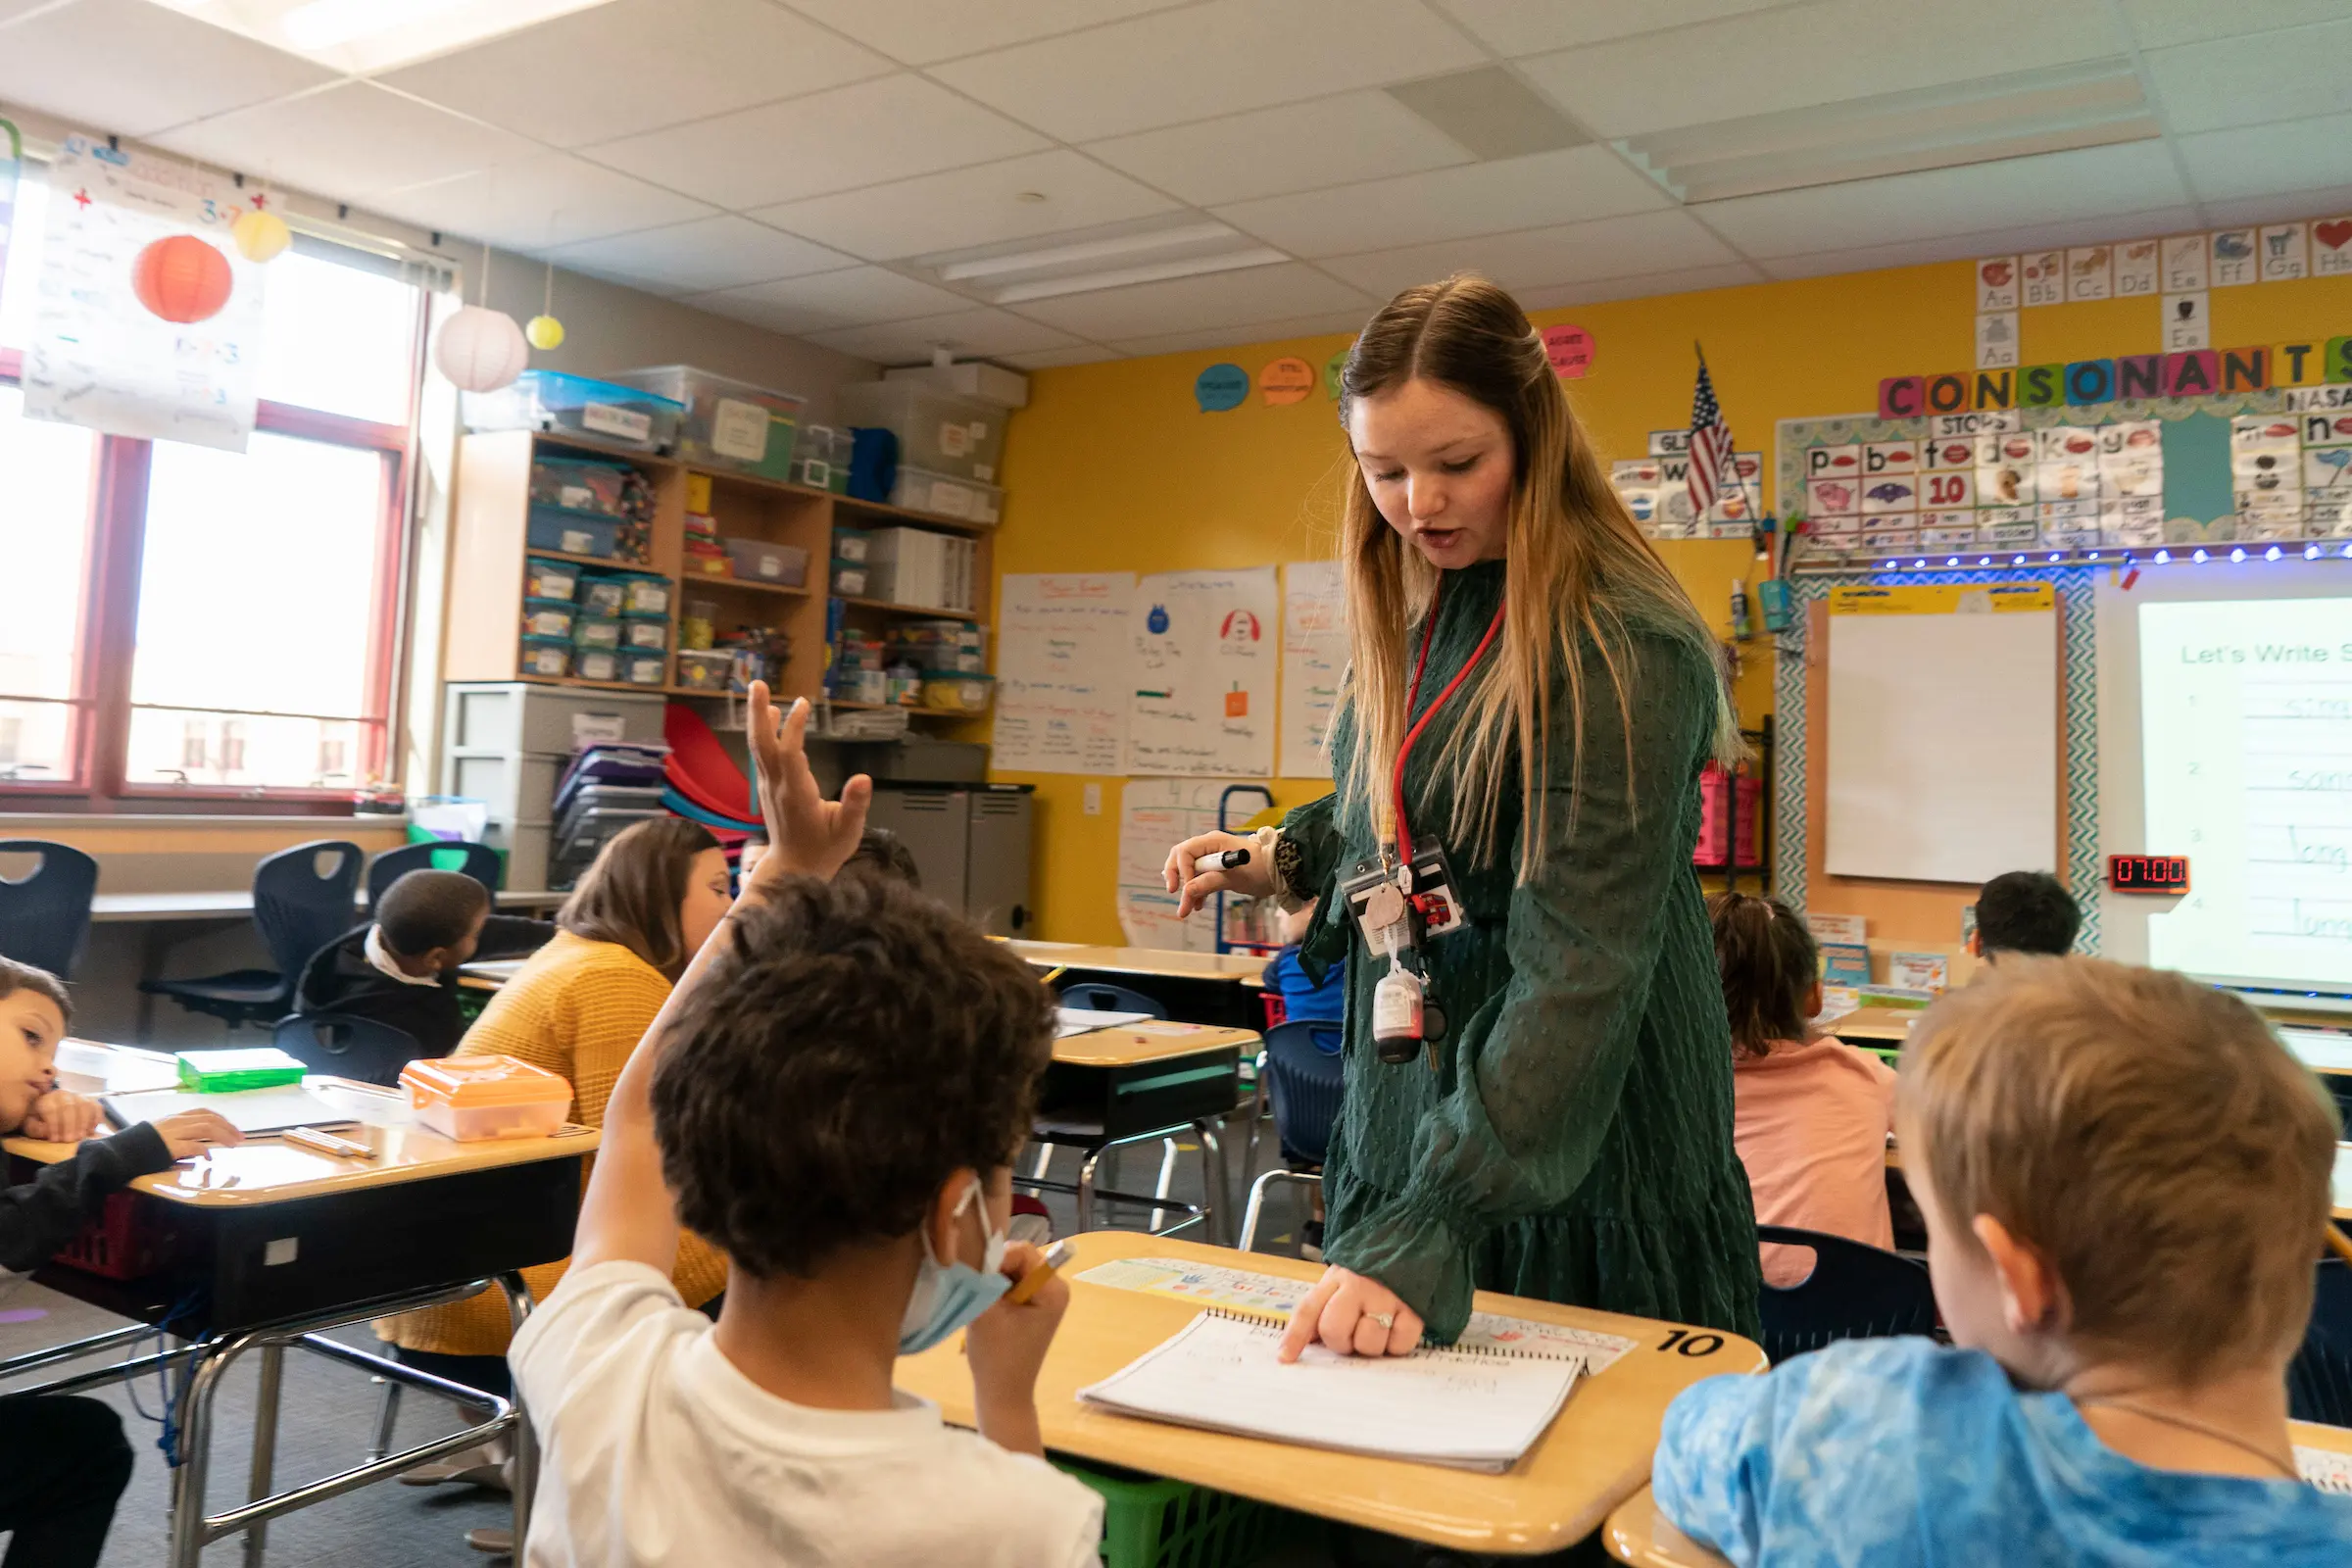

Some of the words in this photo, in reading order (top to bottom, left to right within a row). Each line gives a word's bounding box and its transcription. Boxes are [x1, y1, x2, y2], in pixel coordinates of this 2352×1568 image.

[2220, 263, 2243, 284] Ff
[2266, 258, 2302, 278] Gg
[2076, 279, 2104, 298] Cc
[2122, 273, 2153, 294] Dd
[2172, 270, 2197, 289] Ee
[1984, 291, 2013, 309] Aa
[2029, 284, 2057, 303] Bb
[2173, 329, 2199, 348] Ee
[1984, 347, 2013, 366] Aa
[2308, 416, 2330, 441] n
[1811, 450, 1830, 476] p
[1867, 447, 1886, 472] b
[1925, 441, 1938, 468] t
[1929, 475, 1965, 505] 10
[2181, 646, 2246, 664] Let's
[2255, 644, 2329, 663] Write
[1657, 1330, 1724, 1356] 10
